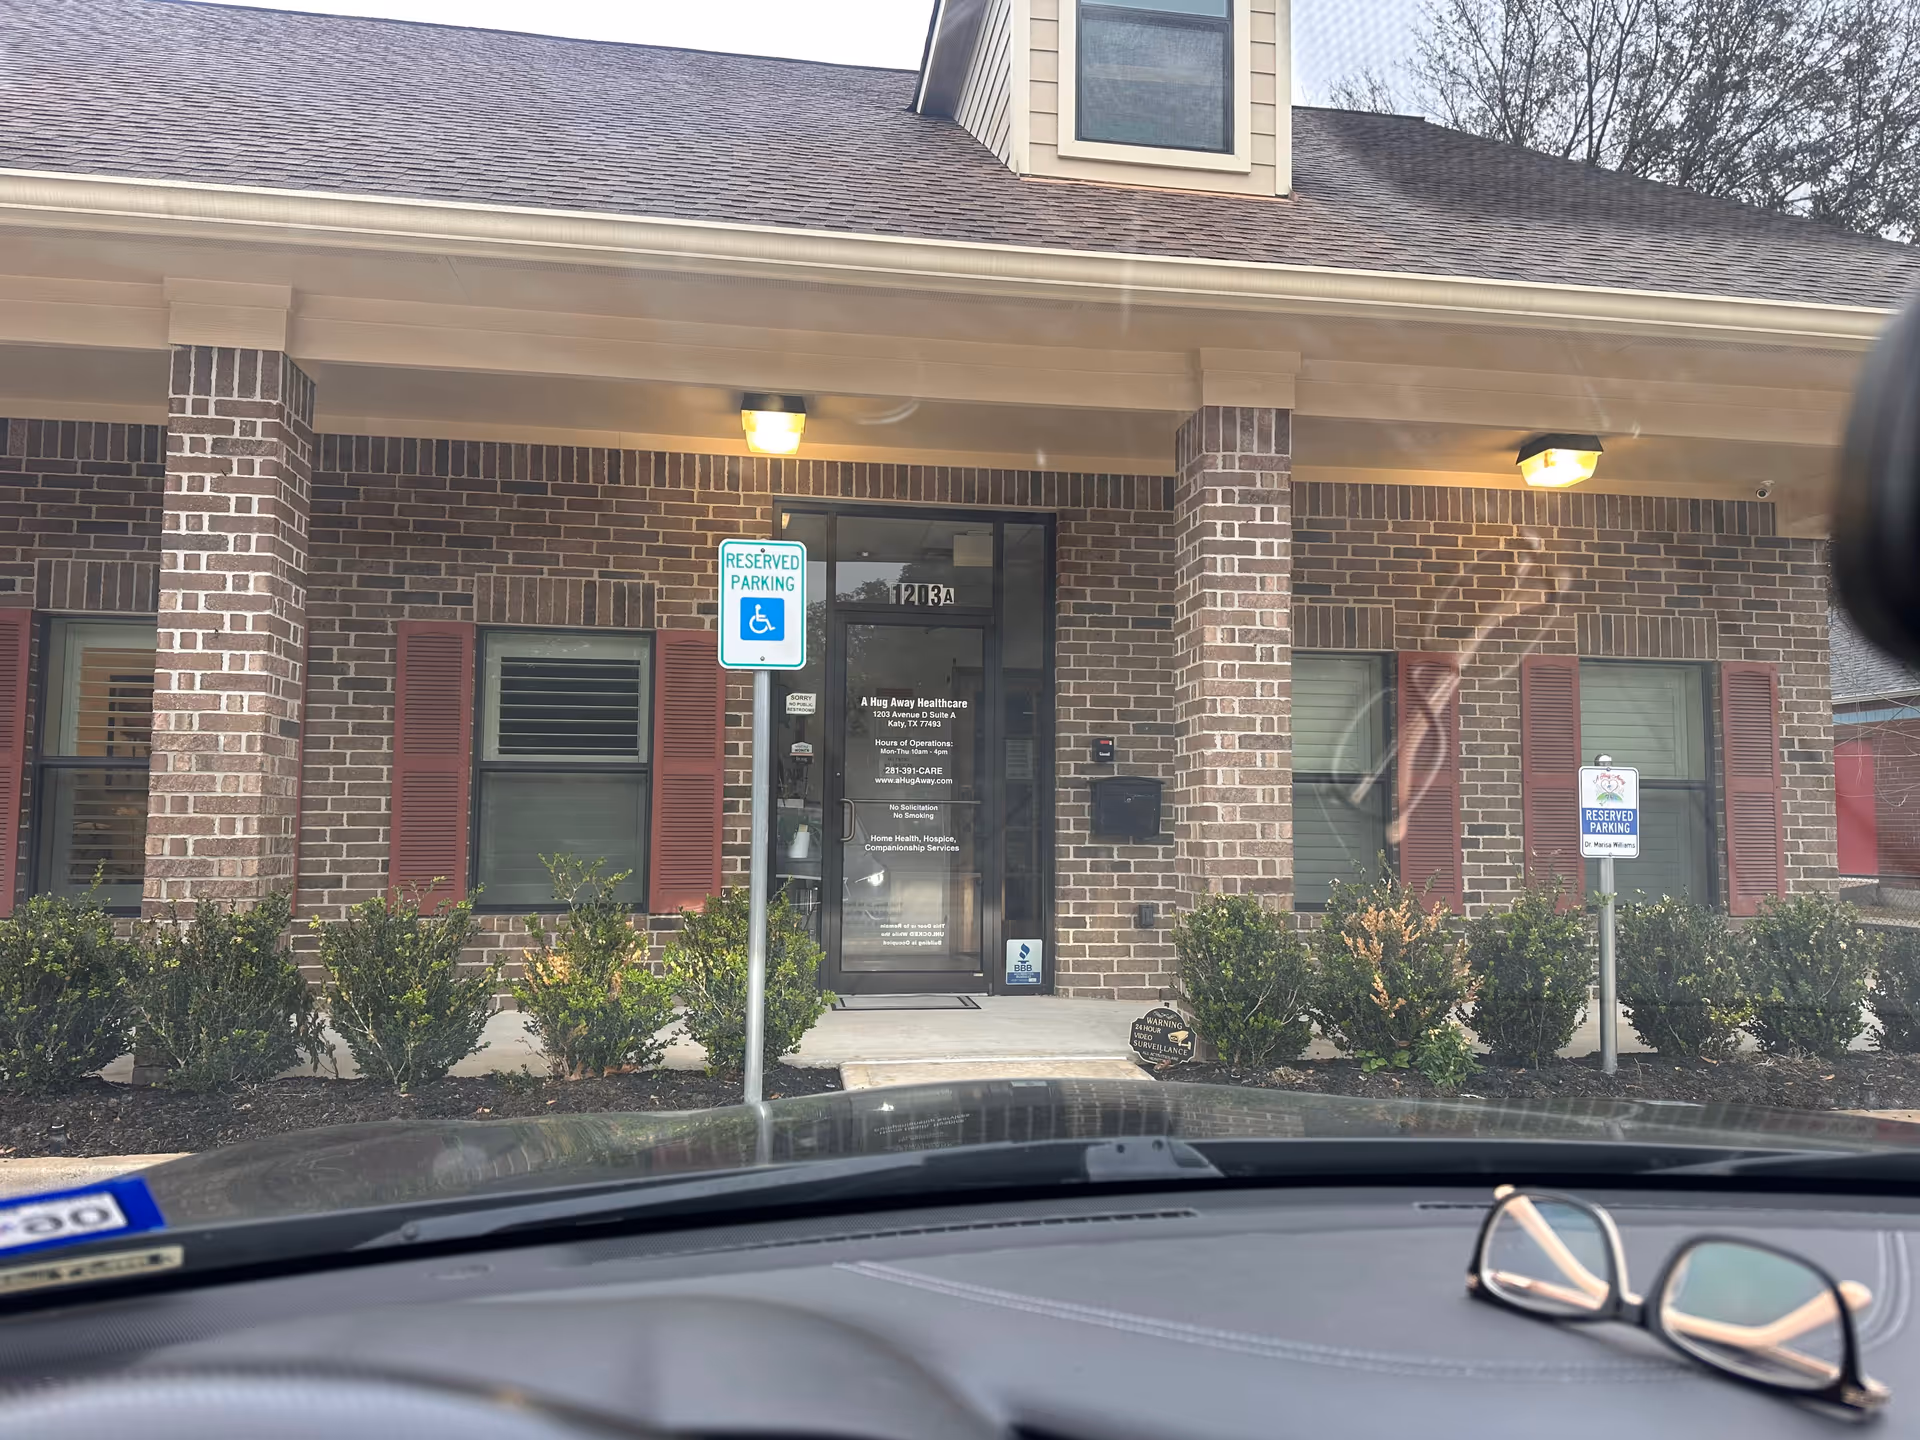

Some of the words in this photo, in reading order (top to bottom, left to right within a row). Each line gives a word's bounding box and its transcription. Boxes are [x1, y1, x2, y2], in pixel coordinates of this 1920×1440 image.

[726, 553, 800, 570] RESERVED
[731, 575, 795, 592] PARKING
[861, 697, 868, 707] A
[870, 697, 888, 709] Hug
[891, 697, 915, 709] Away
[918, 698, 968, 708] Healthcare
[888, 720, 906, 729] Katy,
[910, 740, 954, 748] Operations:
[885, 767, 942, 775] 281-391-CARE
[875, 777, 953, 785] www.aHugAway.com
[904, 812, 934, 820] Smoking
[1586, 809, 1633, 822] RESERVED
[1590, 822, 1630, 834] PARKING
[895, 835, 921, 843] Health,
[924, 835, 956, 843] Hospice,
[865, 844, 925, 852] Companionship
[927, 844, 960, 852] Services
[1613, 841, 1635, 849] Williams
[1146, 1017, 1183, 1030] WARNING
[1143, 1026, 1161, 1034] HOUR
[1134, 1032, 1153, 1040] VIDEO
[1133, 1040, 1188, 1056] SURVEILLANCE
